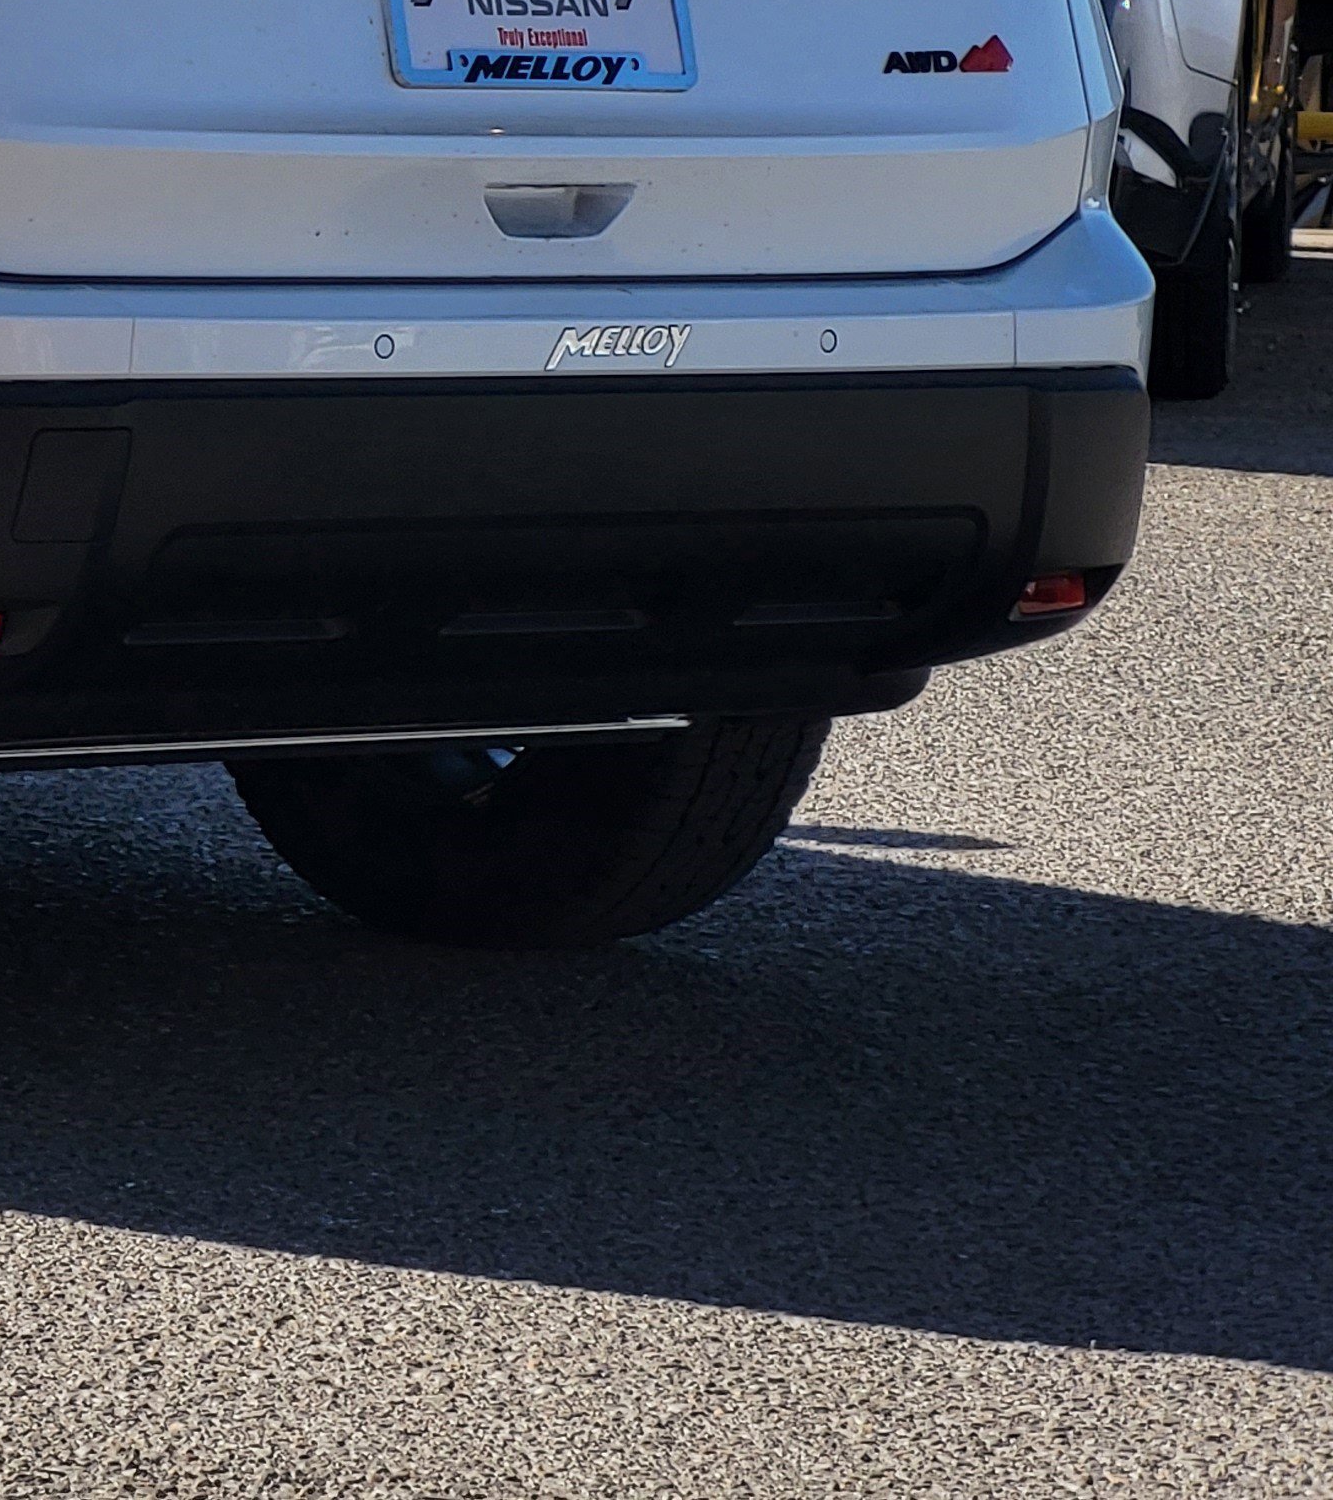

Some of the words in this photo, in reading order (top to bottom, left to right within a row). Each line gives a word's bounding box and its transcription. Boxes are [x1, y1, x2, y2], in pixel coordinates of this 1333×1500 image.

[497, 27, 524, 49] Truly
[527, 28, 588, 48] Exceptional
[464, 54, 627, 85] MELLOY
[883, 50, 958, 74] AWD
[544, 324, 693, 371] MELLOY
